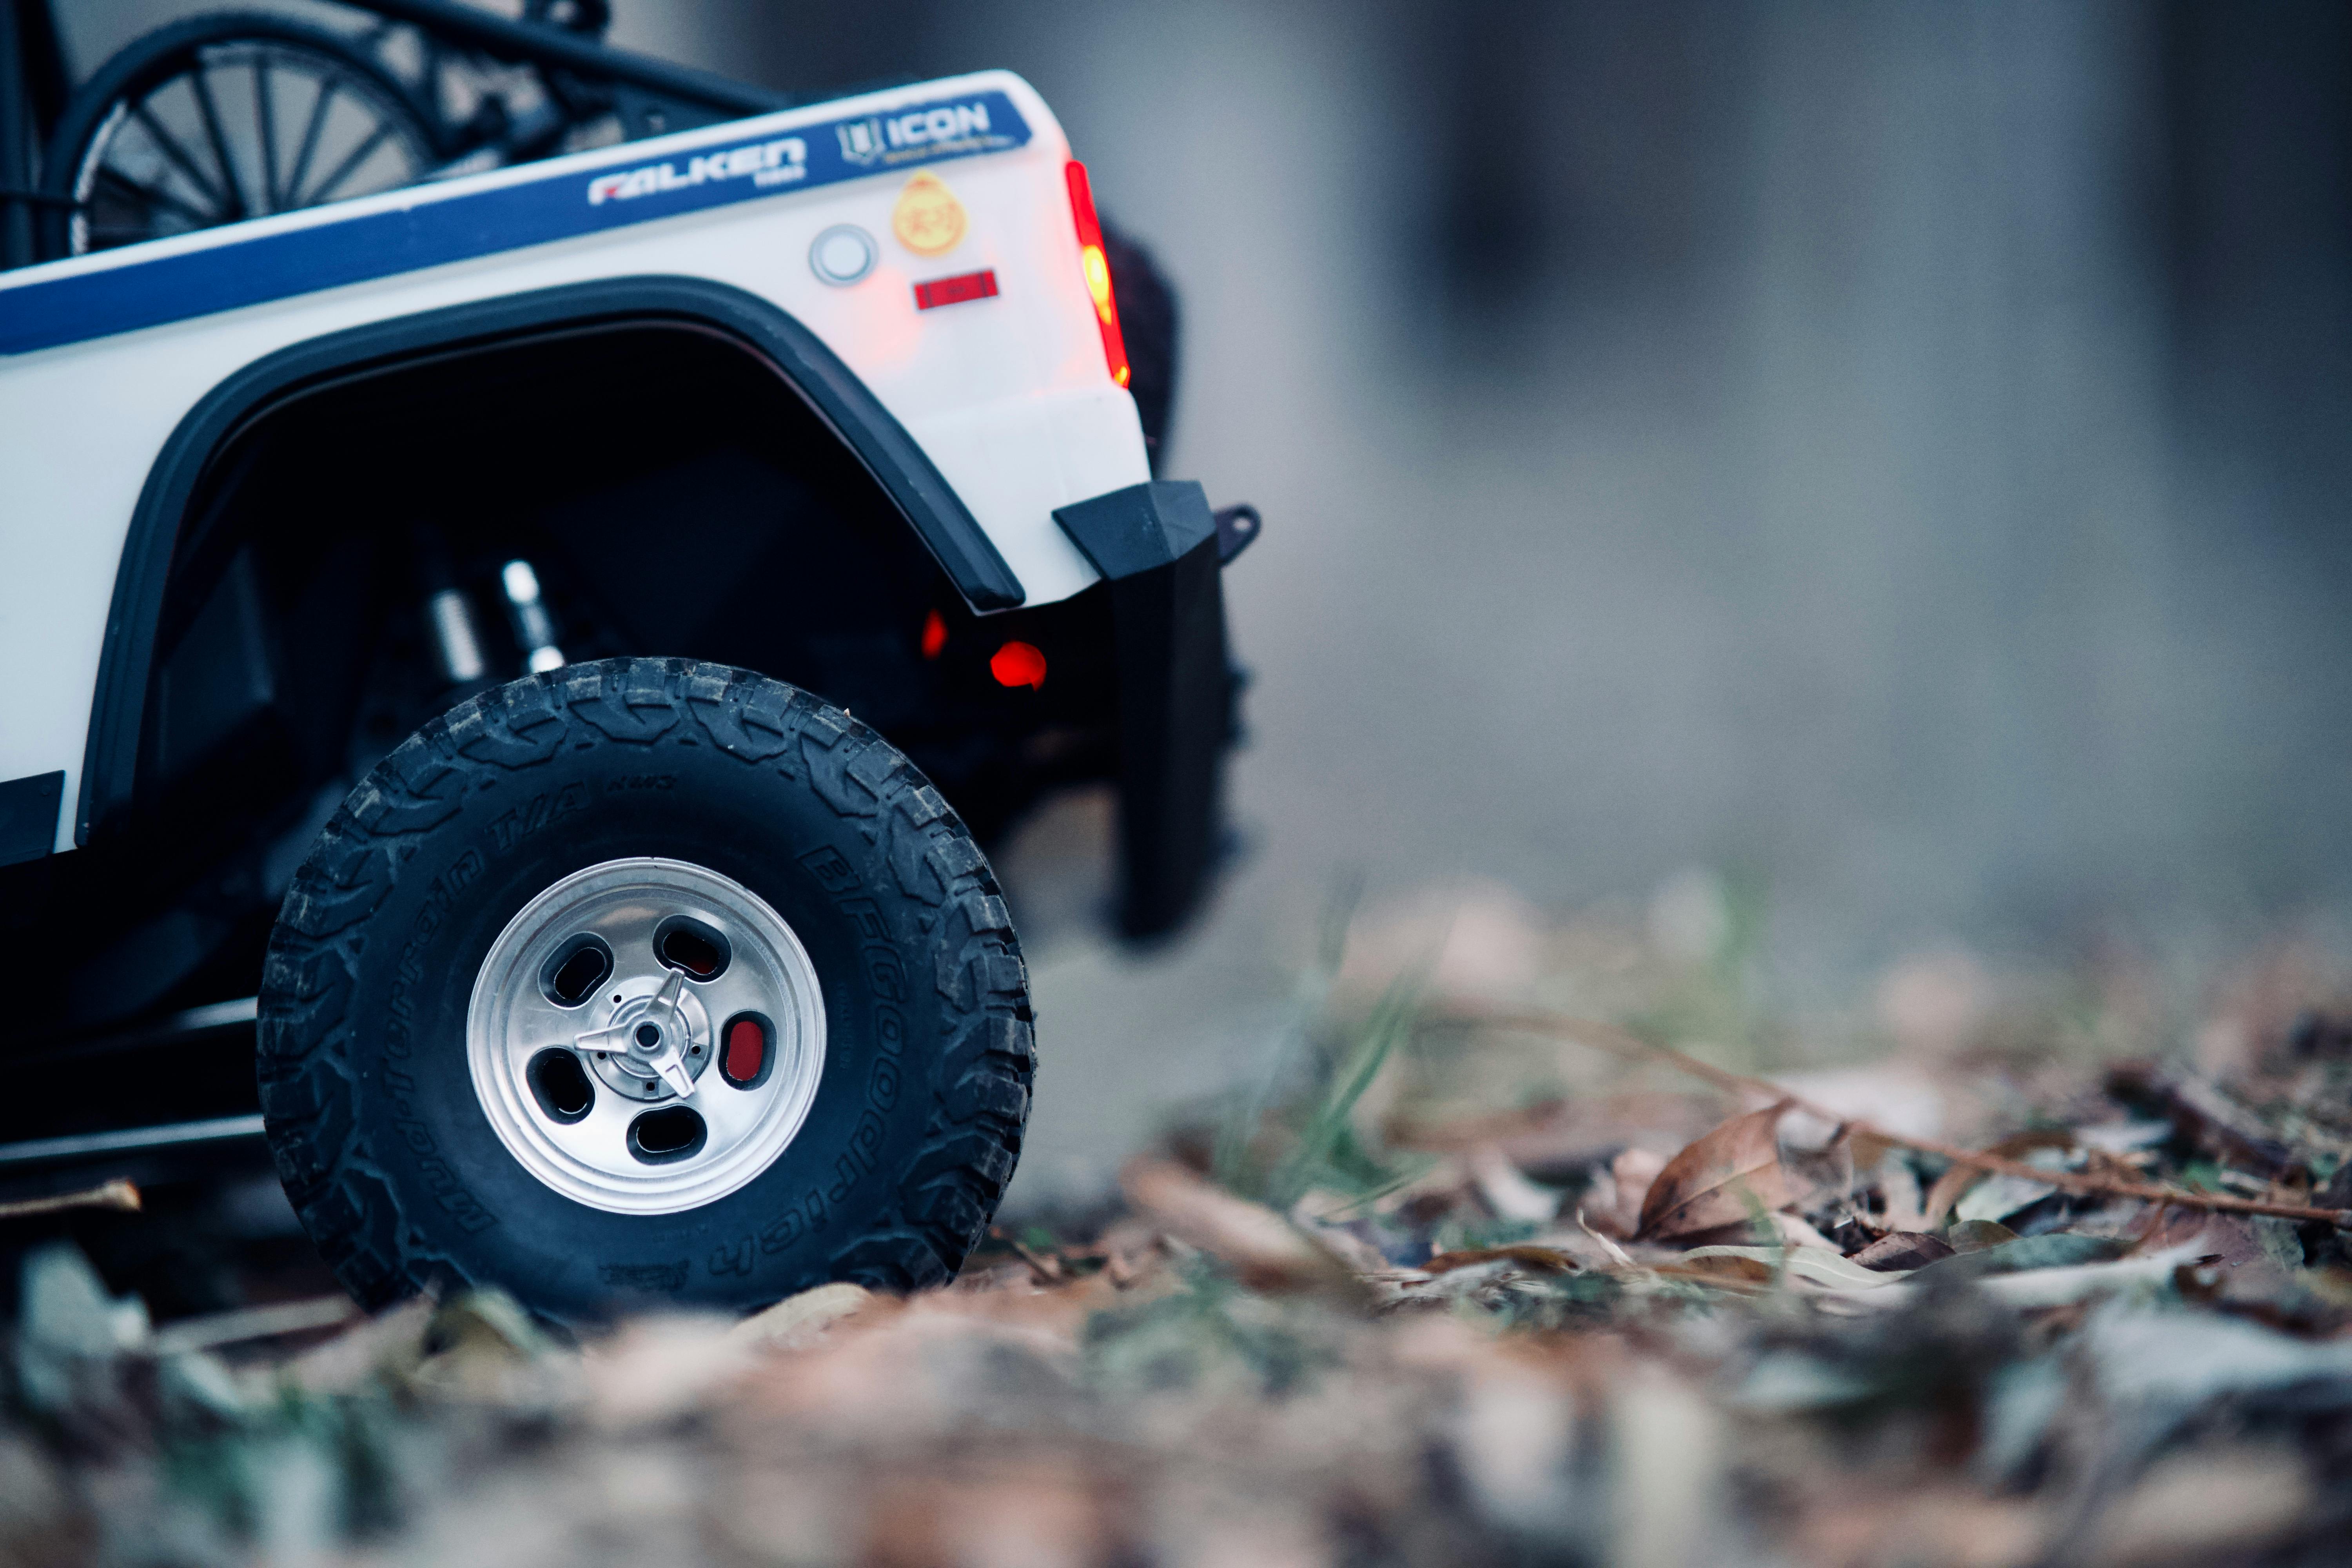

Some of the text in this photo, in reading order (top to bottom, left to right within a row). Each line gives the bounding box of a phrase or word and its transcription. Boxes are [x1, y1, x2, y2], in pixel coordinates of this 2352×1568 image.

[589, 137, 806, 205] FALKEN
[887, 102, 990, 148] ICON
[382, 845, 499, 1234] Mud-Terrain
[484, 782, 590, 852] T/A
[707, 845, 907, 1277] BFGoodrich
